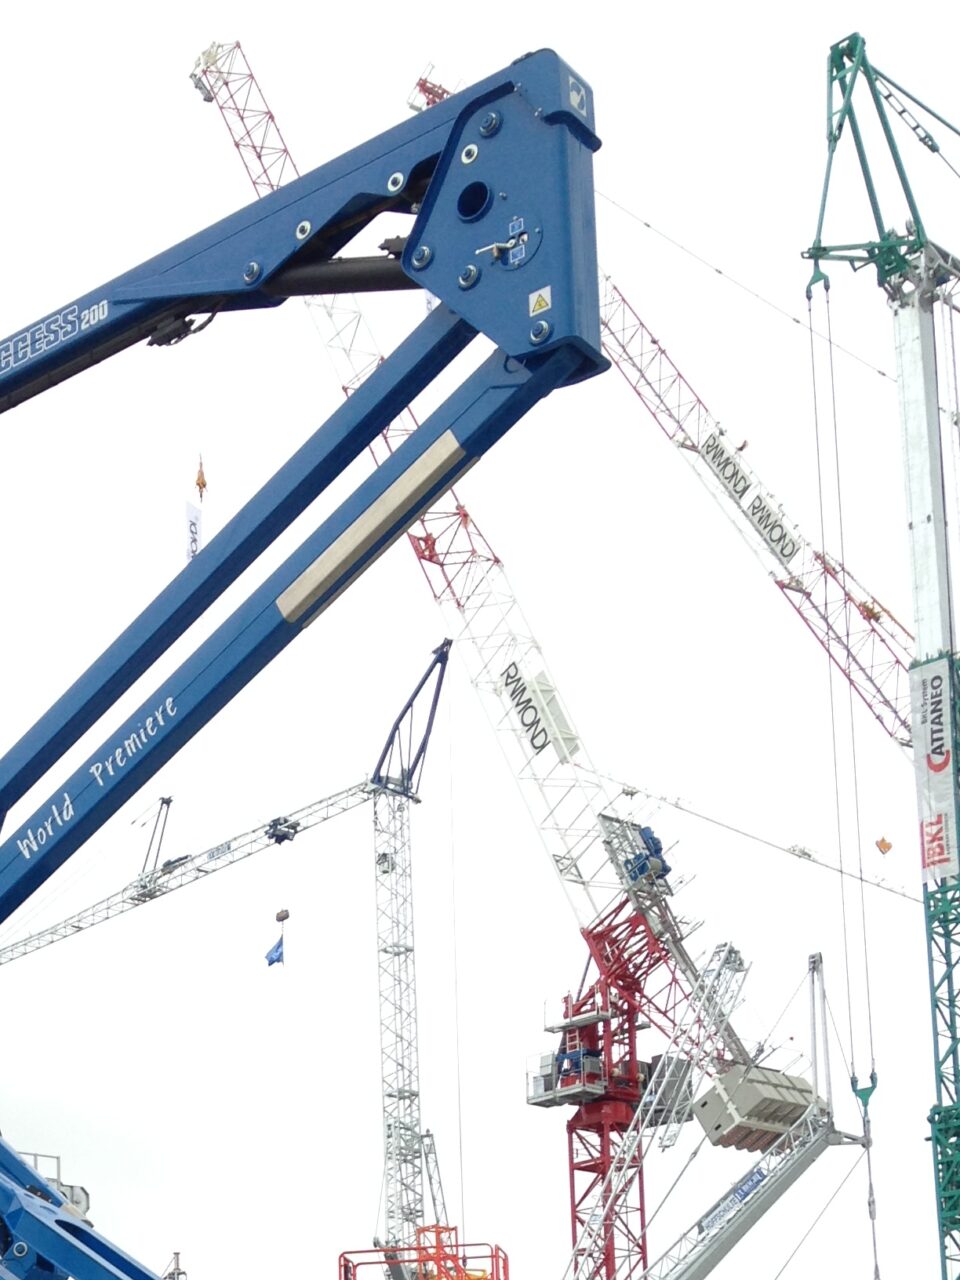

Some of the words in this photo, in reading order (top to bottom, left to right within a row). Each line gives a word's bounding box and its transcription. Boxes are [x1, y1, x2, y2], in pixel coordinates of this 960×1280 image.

[80, 299, 109, 330] 200
[701, 432, 752, 501] RAIMONDI
[747, 494, 802, 566] RAIMONDI
[500, 661, 551, 756] RAIMONDI
[926, 674, 951, 773] CATTANEO
[16, 792, 75, 860] World
[89, 696, 178, 787] Premiere
